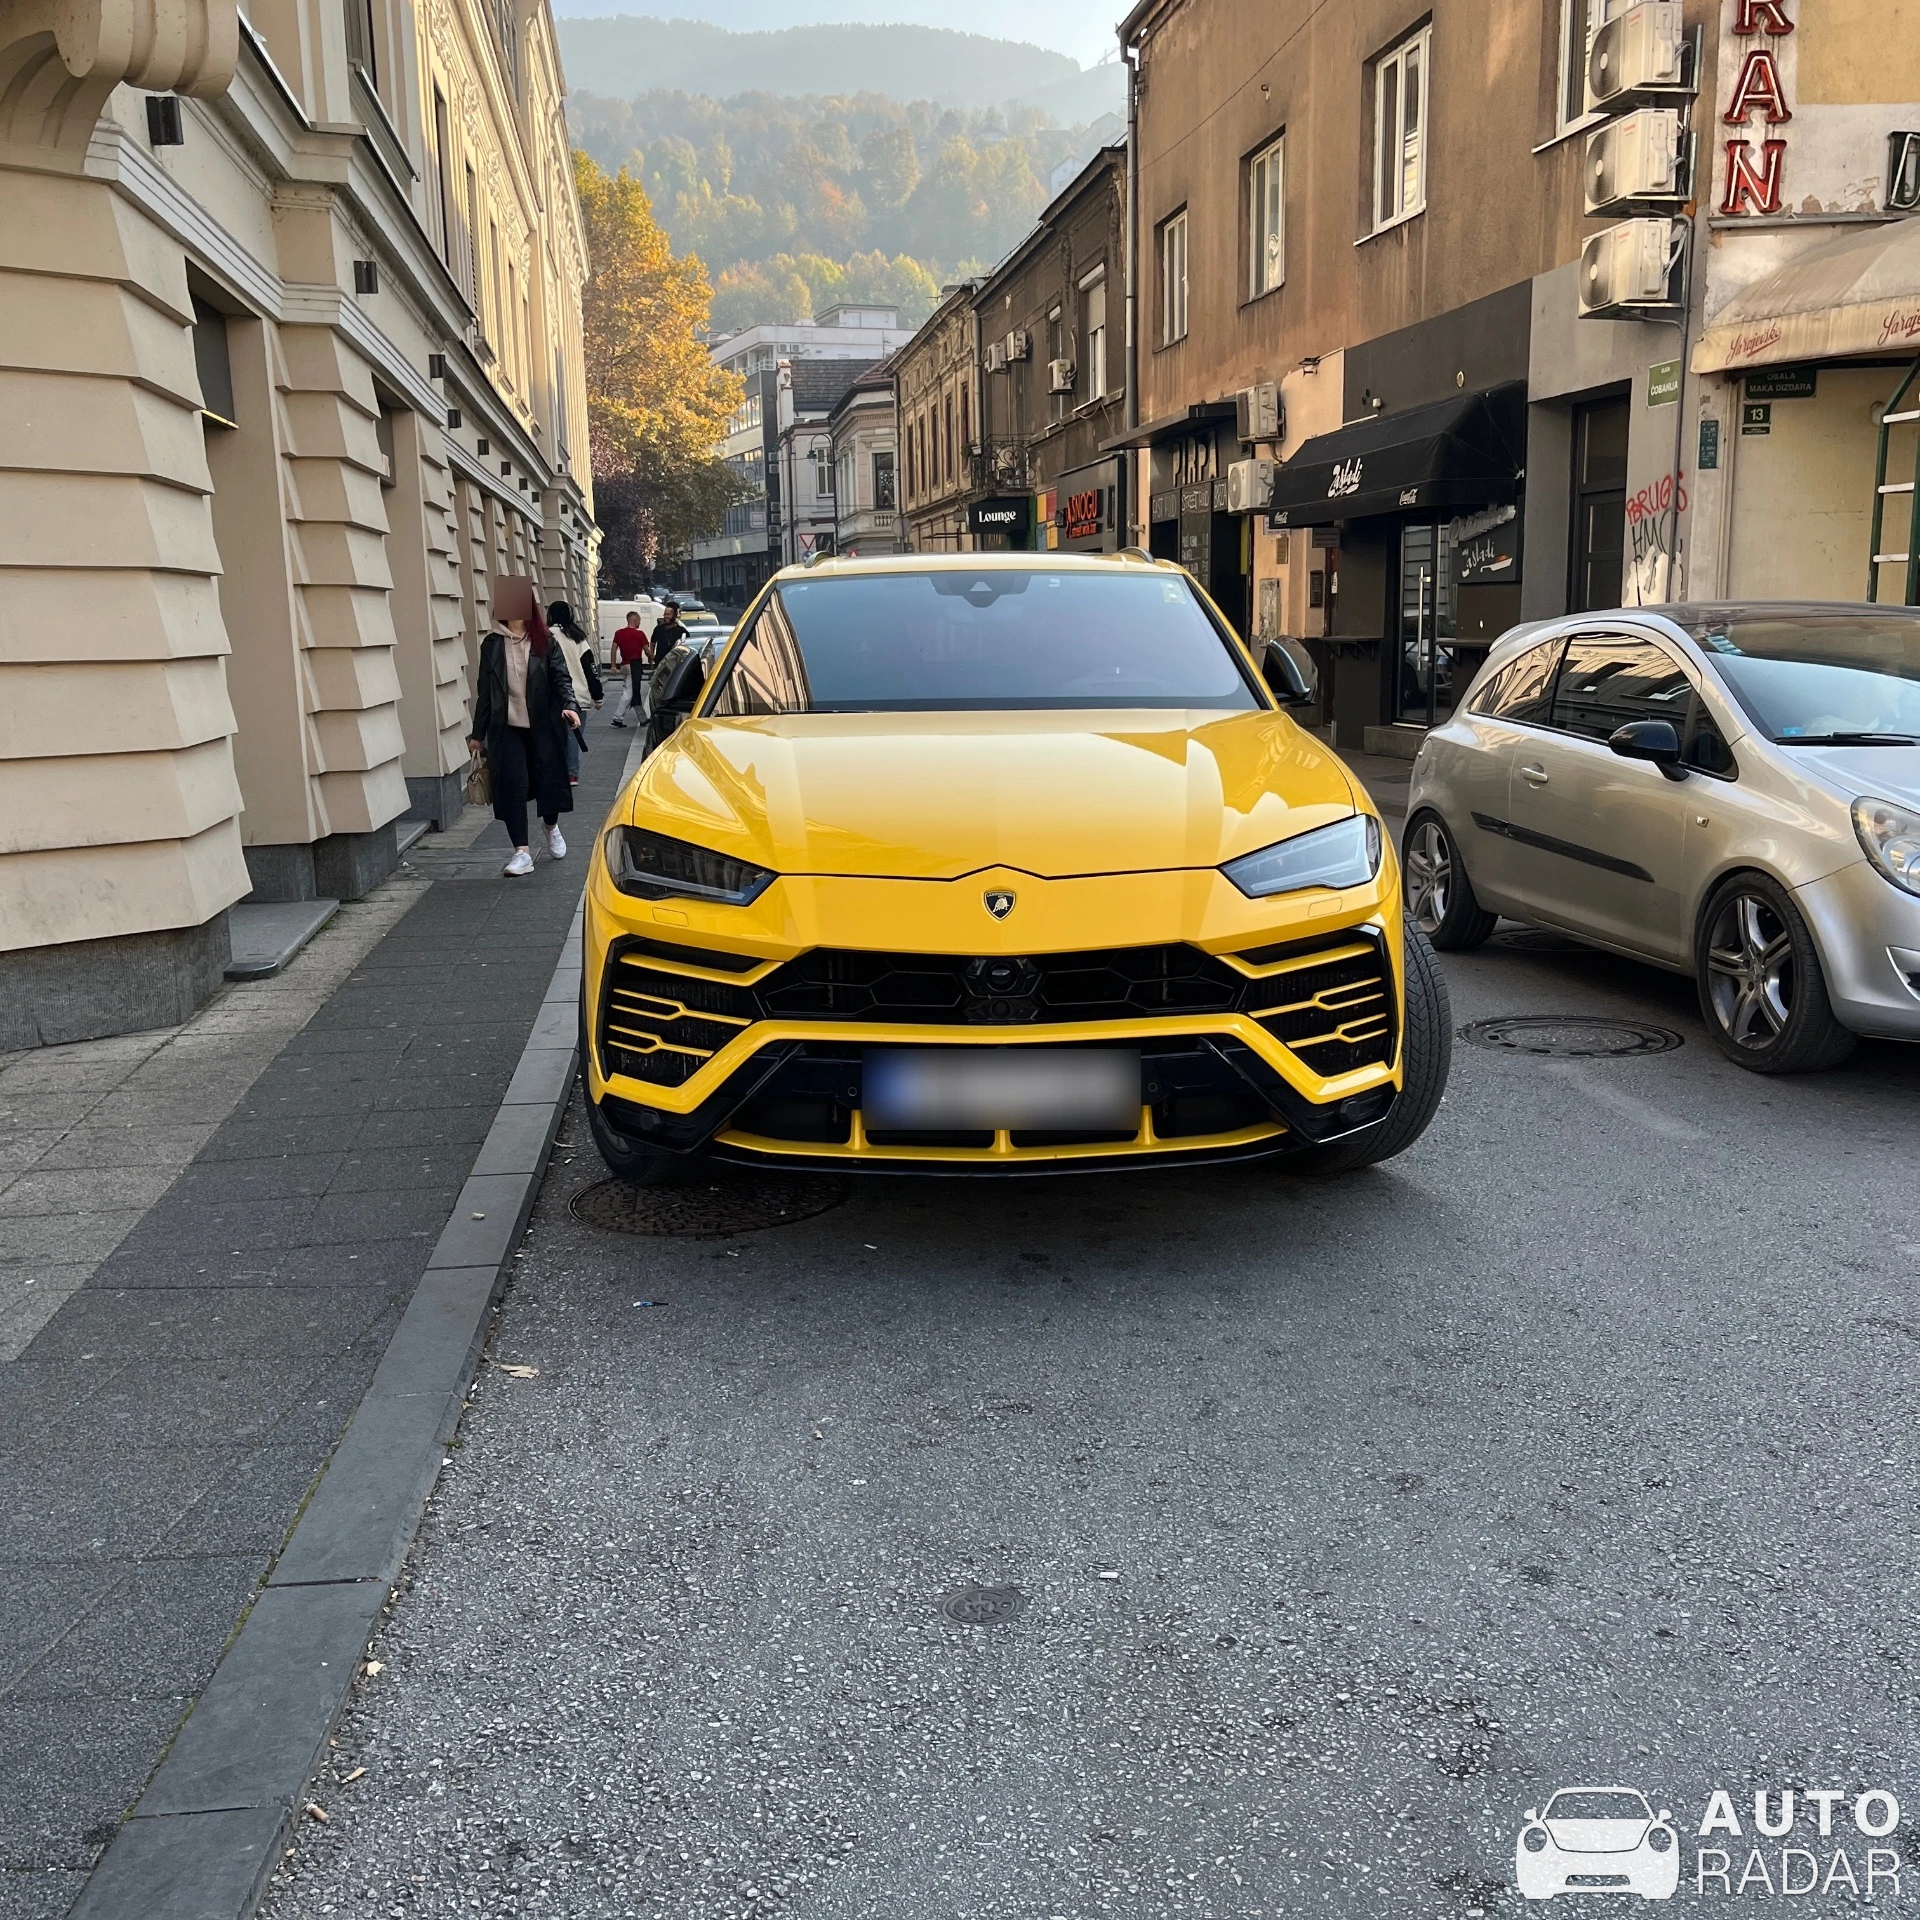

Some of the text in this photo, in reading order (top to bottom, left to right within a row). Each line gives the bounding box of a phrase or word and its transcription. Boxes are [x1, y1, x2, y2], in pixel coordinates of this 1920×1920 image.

[1766, 372, 1796, 380] OBALA
[1650, 381, 1679, 396] ČOBANIJA
[1749, 383, 1812, 393] MAKA DIZDARA
[1750, 408, 1764, 421] 13
[978, 510, 1017, 524] Lounge
